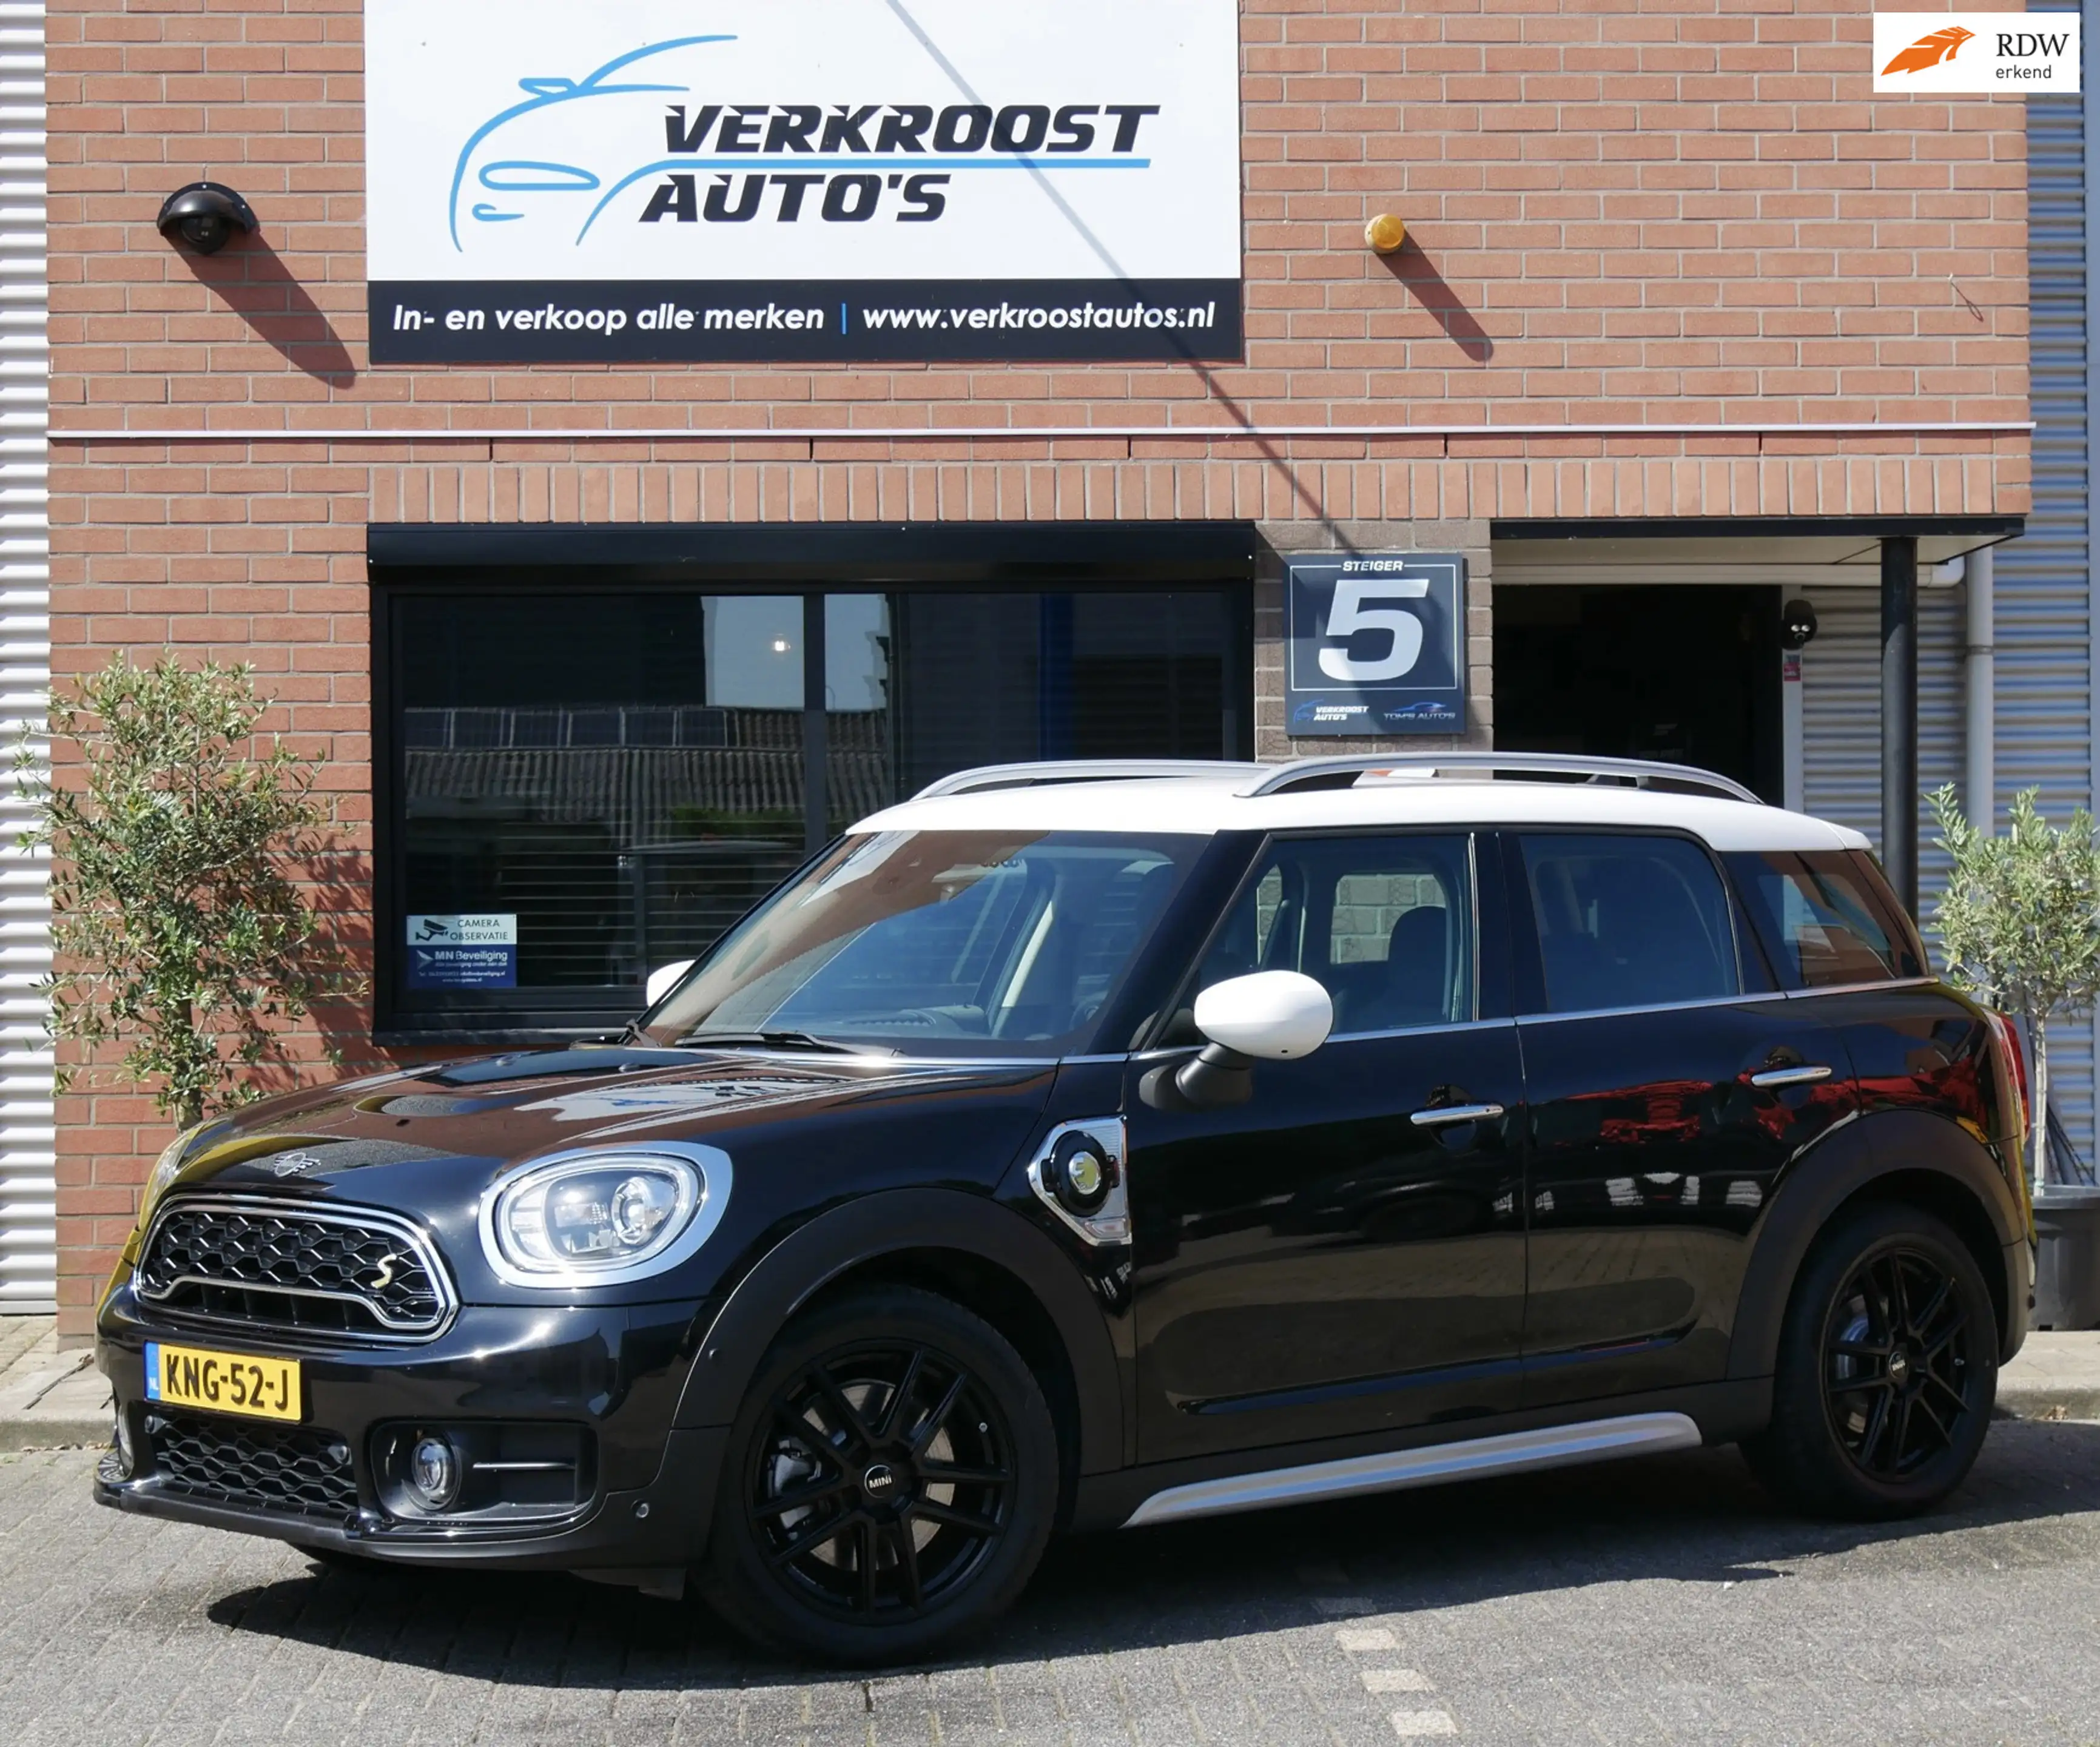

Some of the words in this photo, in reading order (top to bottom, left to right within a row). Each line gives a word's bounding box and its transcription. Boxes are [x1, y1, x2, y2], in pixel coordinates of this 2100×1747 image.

[665, 105, 1160, 152] VERKROOST
[639, 174, 951, 222] AUTO'S
[393, 305, 435, 330] In-
[445, 310, 485, 330] en
[495, 303, 627, 335] verkoop
[636, 303, 695, 329] alle
[704, 309, 824, 329] merken
[863, 302, 1215, 329] www.verkroostautos.nl
[1342, 560, 1404, 571] STEIGER
[1318, 578, 1430, 681] 5
[457, 919, 499, 927] CAMERA
[449, 932, 508, 940] OBSERVATIE
[435, 951, 454, 960] MN
[456, 951, 508, 961] Beveiliging
[166, 1354, 288, 1412] KNG-52-J
[869, 1475, 892, 1489] MINI
